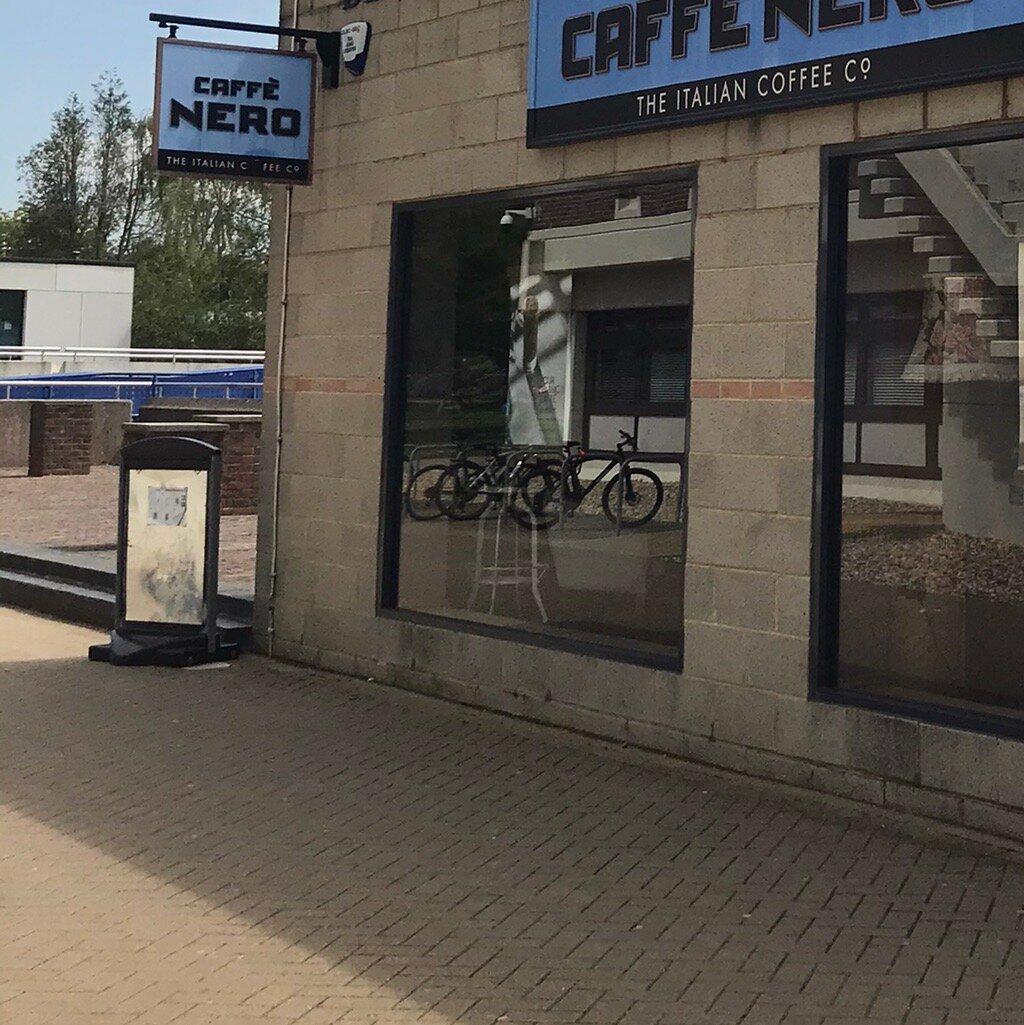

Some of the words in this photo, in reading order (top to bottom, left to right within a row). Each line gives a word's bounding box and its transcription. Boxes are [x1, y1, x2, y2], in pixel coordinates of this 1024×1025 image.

[193, 76, 280, 101] CAFFÈ
[636, 91, 667, 117] THE
[675, 77, 748, 111] ITALIAN
[756, 62, 833, 97] COFFEE
[169, 98, 302, 138] NERO
[166, 156, 187, 167] THE
[191, 158, 236, 170] ITALIAN
